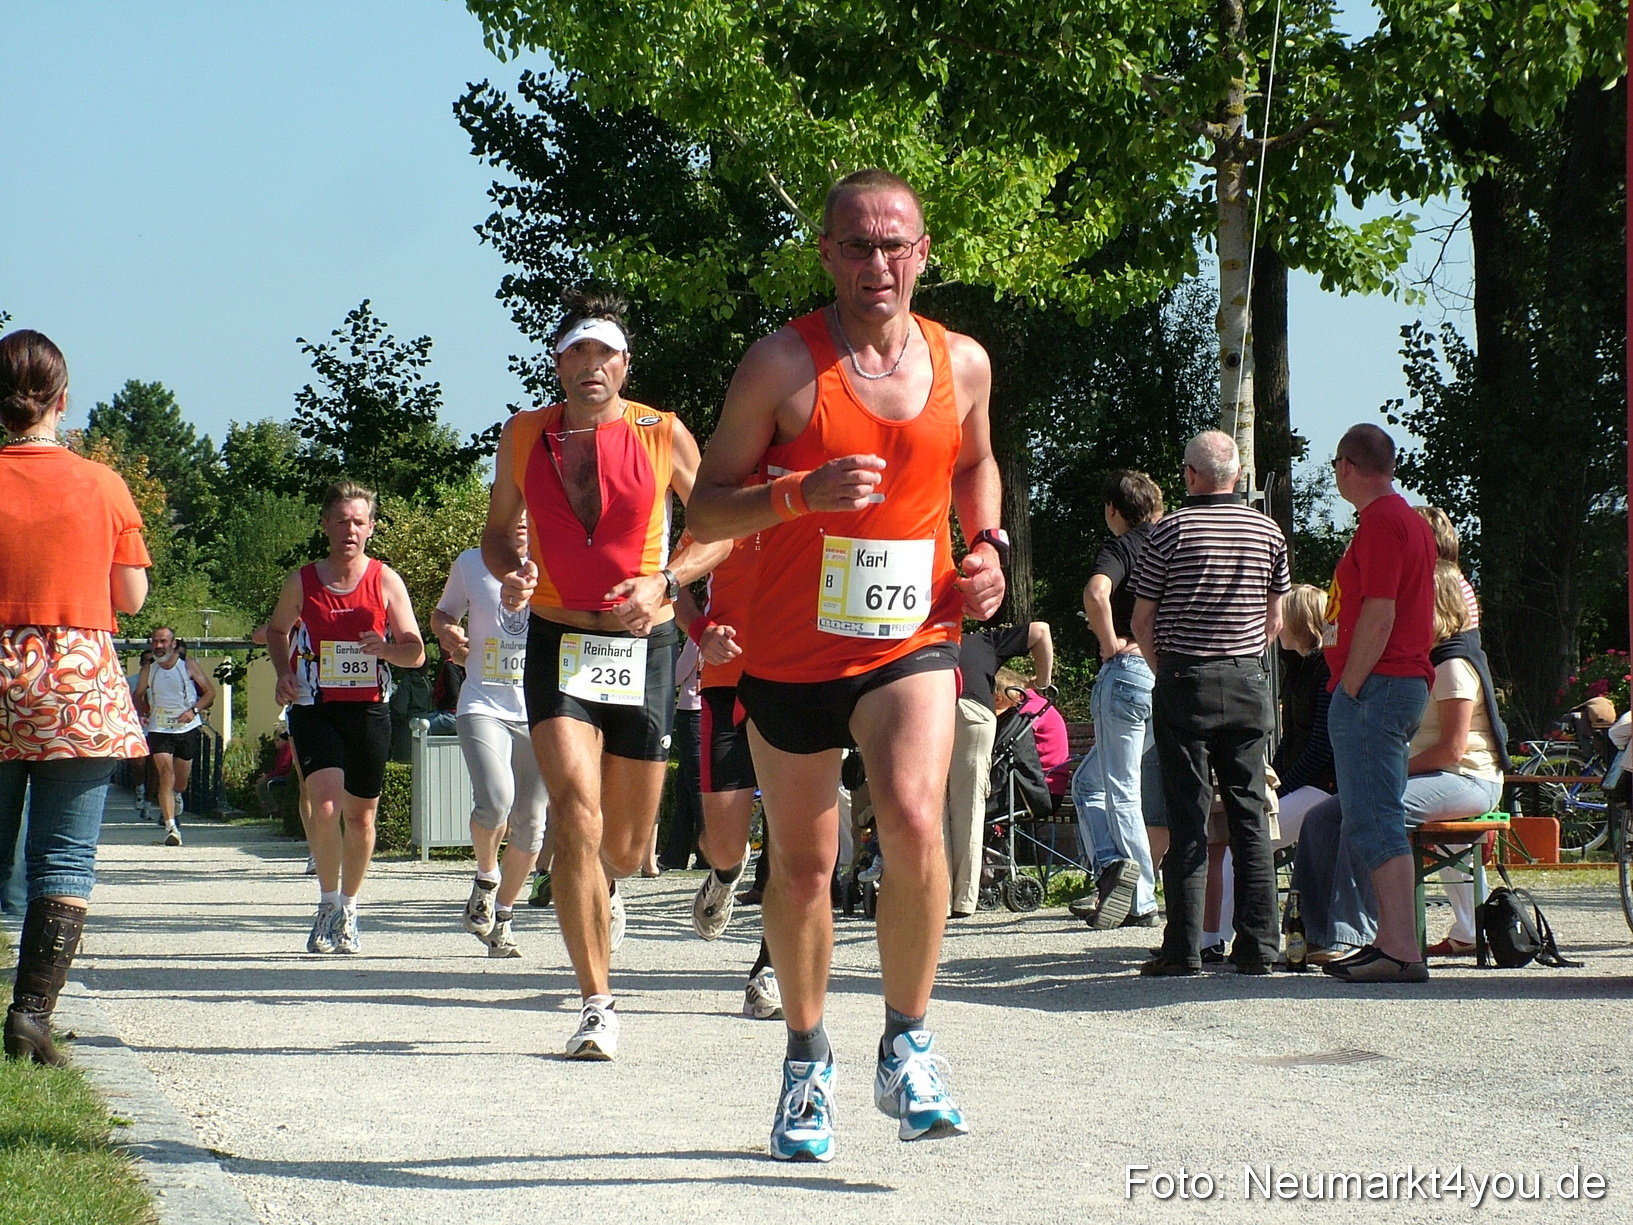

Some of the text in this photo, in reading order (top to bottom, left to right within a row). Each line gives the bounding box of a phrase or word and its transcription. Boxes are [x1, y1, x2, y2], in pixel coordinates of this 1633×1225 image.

[856, 548, 888, 568] Karl
[825, 574, 833, 588] B
[865, 584, 916, 611] 676
[819, 618, 864, 632] BOCK
[584, 641, 633, 658] Reinhard
[341, 661, 369, 674] 983
[590, 667, 631, 686] 236
